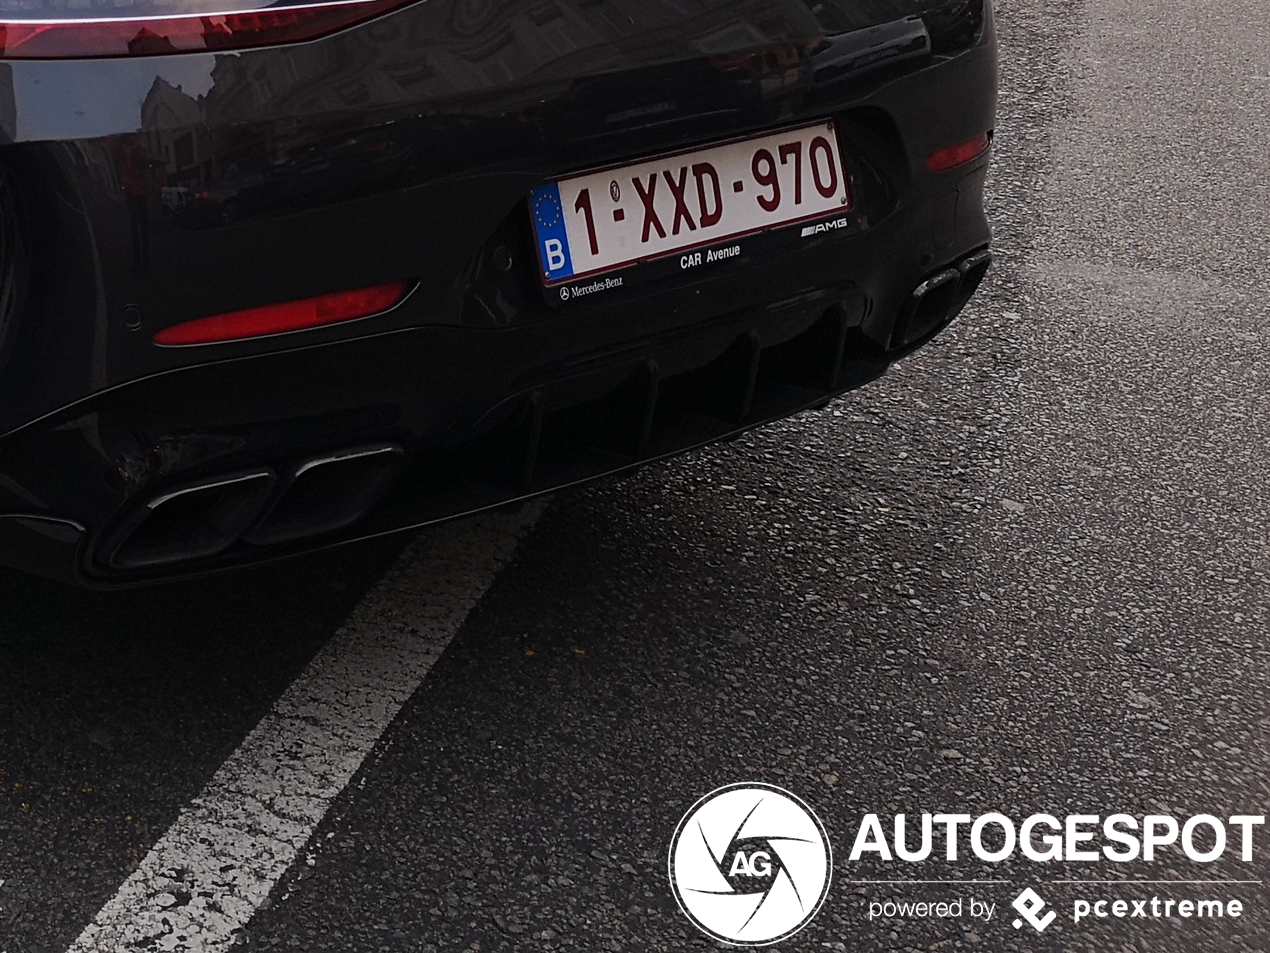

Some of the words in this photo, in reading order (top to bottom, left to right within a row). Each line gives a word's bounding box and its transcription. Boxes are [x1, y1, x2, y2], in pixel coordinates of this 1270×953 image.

[574, 136, 838, 256] 1-XXD-970
[815, 218, 848, 234] AMG
[544, 238, 566, 271] B
[680, 252, 703, 269] CAR
[705, 245, 741, 263] Avenue
[571, 276, 624, 297] Mercedes-Benz
